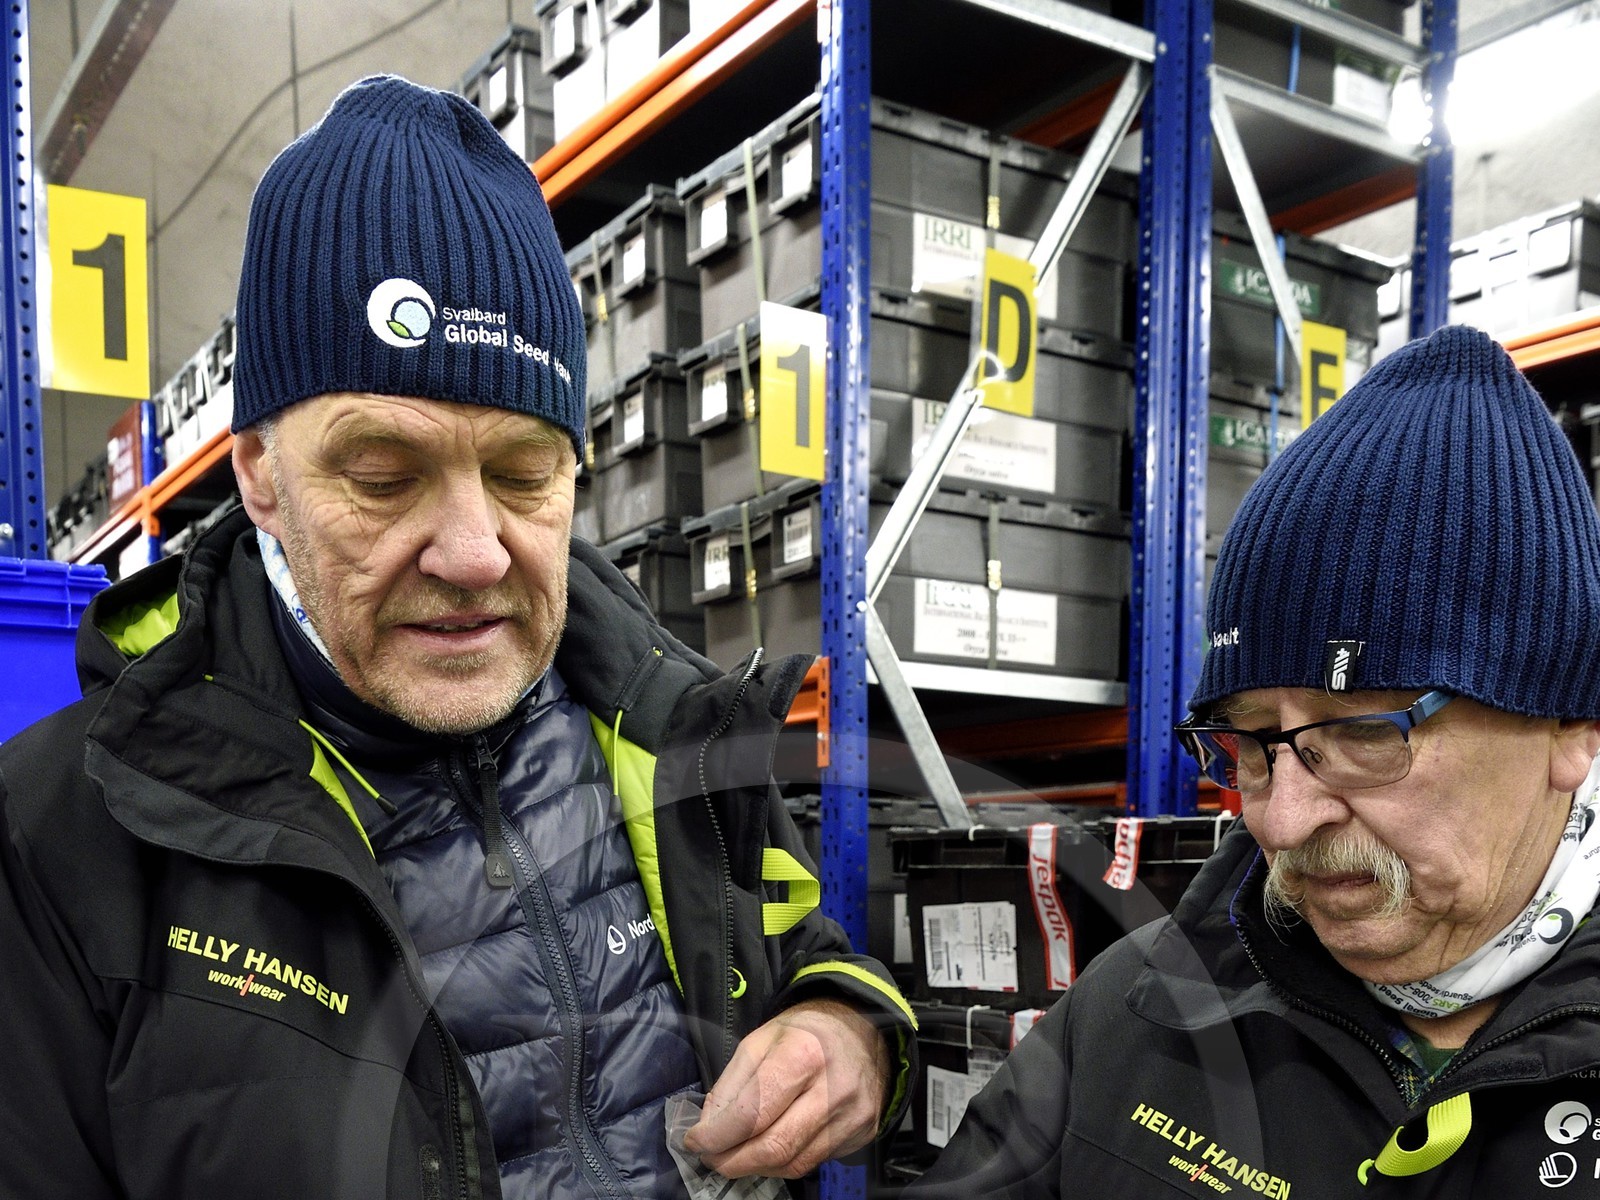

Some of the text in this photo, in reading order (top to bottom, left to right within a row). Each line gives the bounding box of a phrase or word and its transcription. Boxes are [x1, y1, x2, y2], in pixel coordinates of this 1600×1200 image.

[924, 217, 971, 249] IRRI
[72, 232, 128, 361] 1
[1246, 268, 1313, 305] ICDA
[443, 307, 506, 325] Svalbard
[984, 278, 1031, 383] D
[445, 324, 507, 347] Global
[514, 335, 549, 365] Seed
[777, 344, 810, 448] 1
[627, 913, 655, 939] Nord
[168, 926, 349, 1014] HELLY HANSEN
[1378, 985, 1404, 1006] Seed
[1130, 1103, 1205, 1152] HELLY
